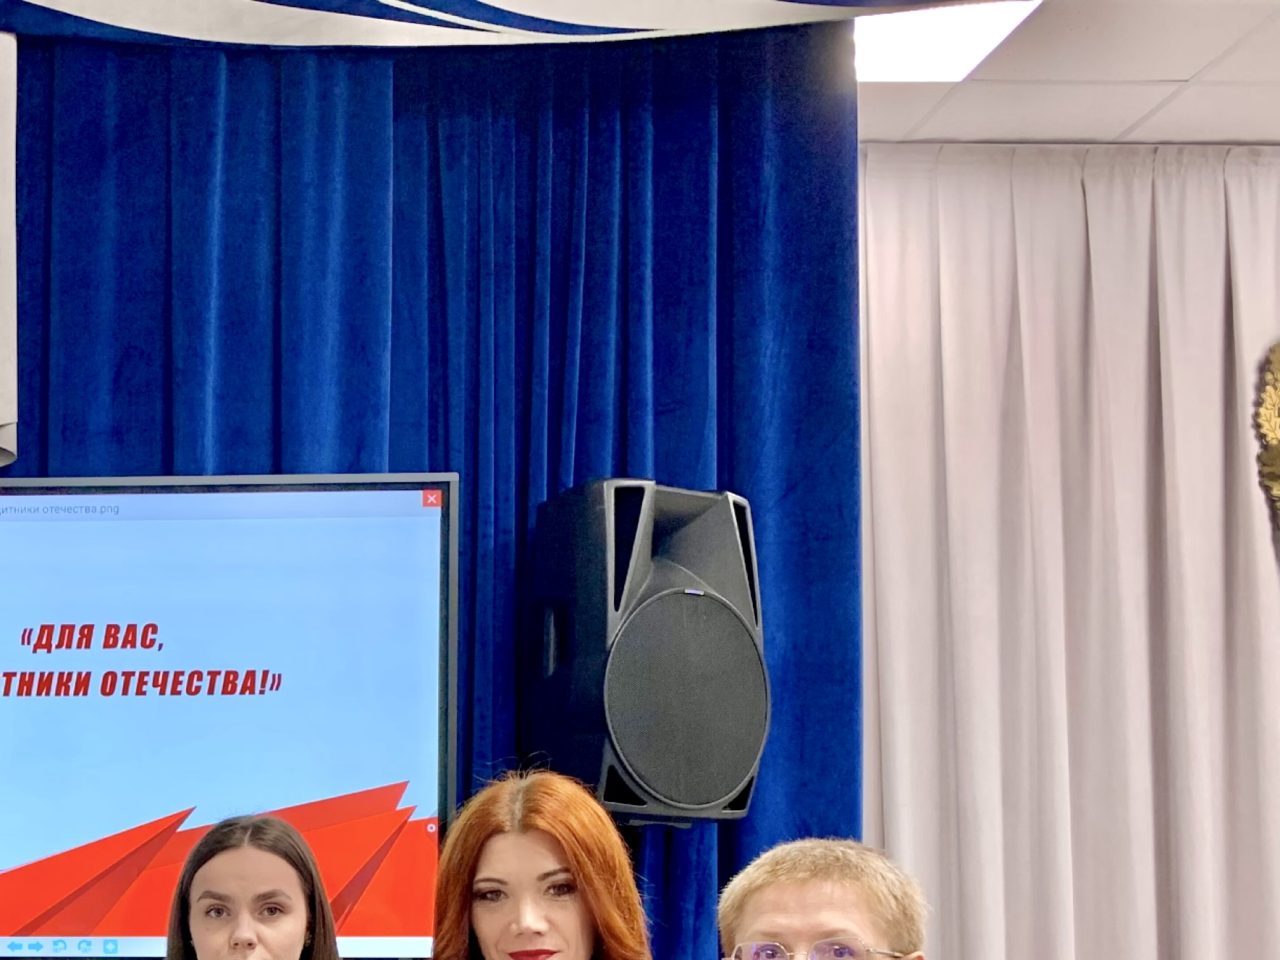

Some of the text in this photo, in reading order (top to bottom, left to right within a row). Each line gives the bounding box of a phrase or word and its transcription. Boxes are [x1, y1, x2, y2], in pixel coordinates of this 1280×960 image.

[42, 504, 120, 516] отечества.png
[20, 623, 164, 654] «ДЛЯ ВАС,
[100, 669, 282, 697] ОТЕЧЕСТВА!»
